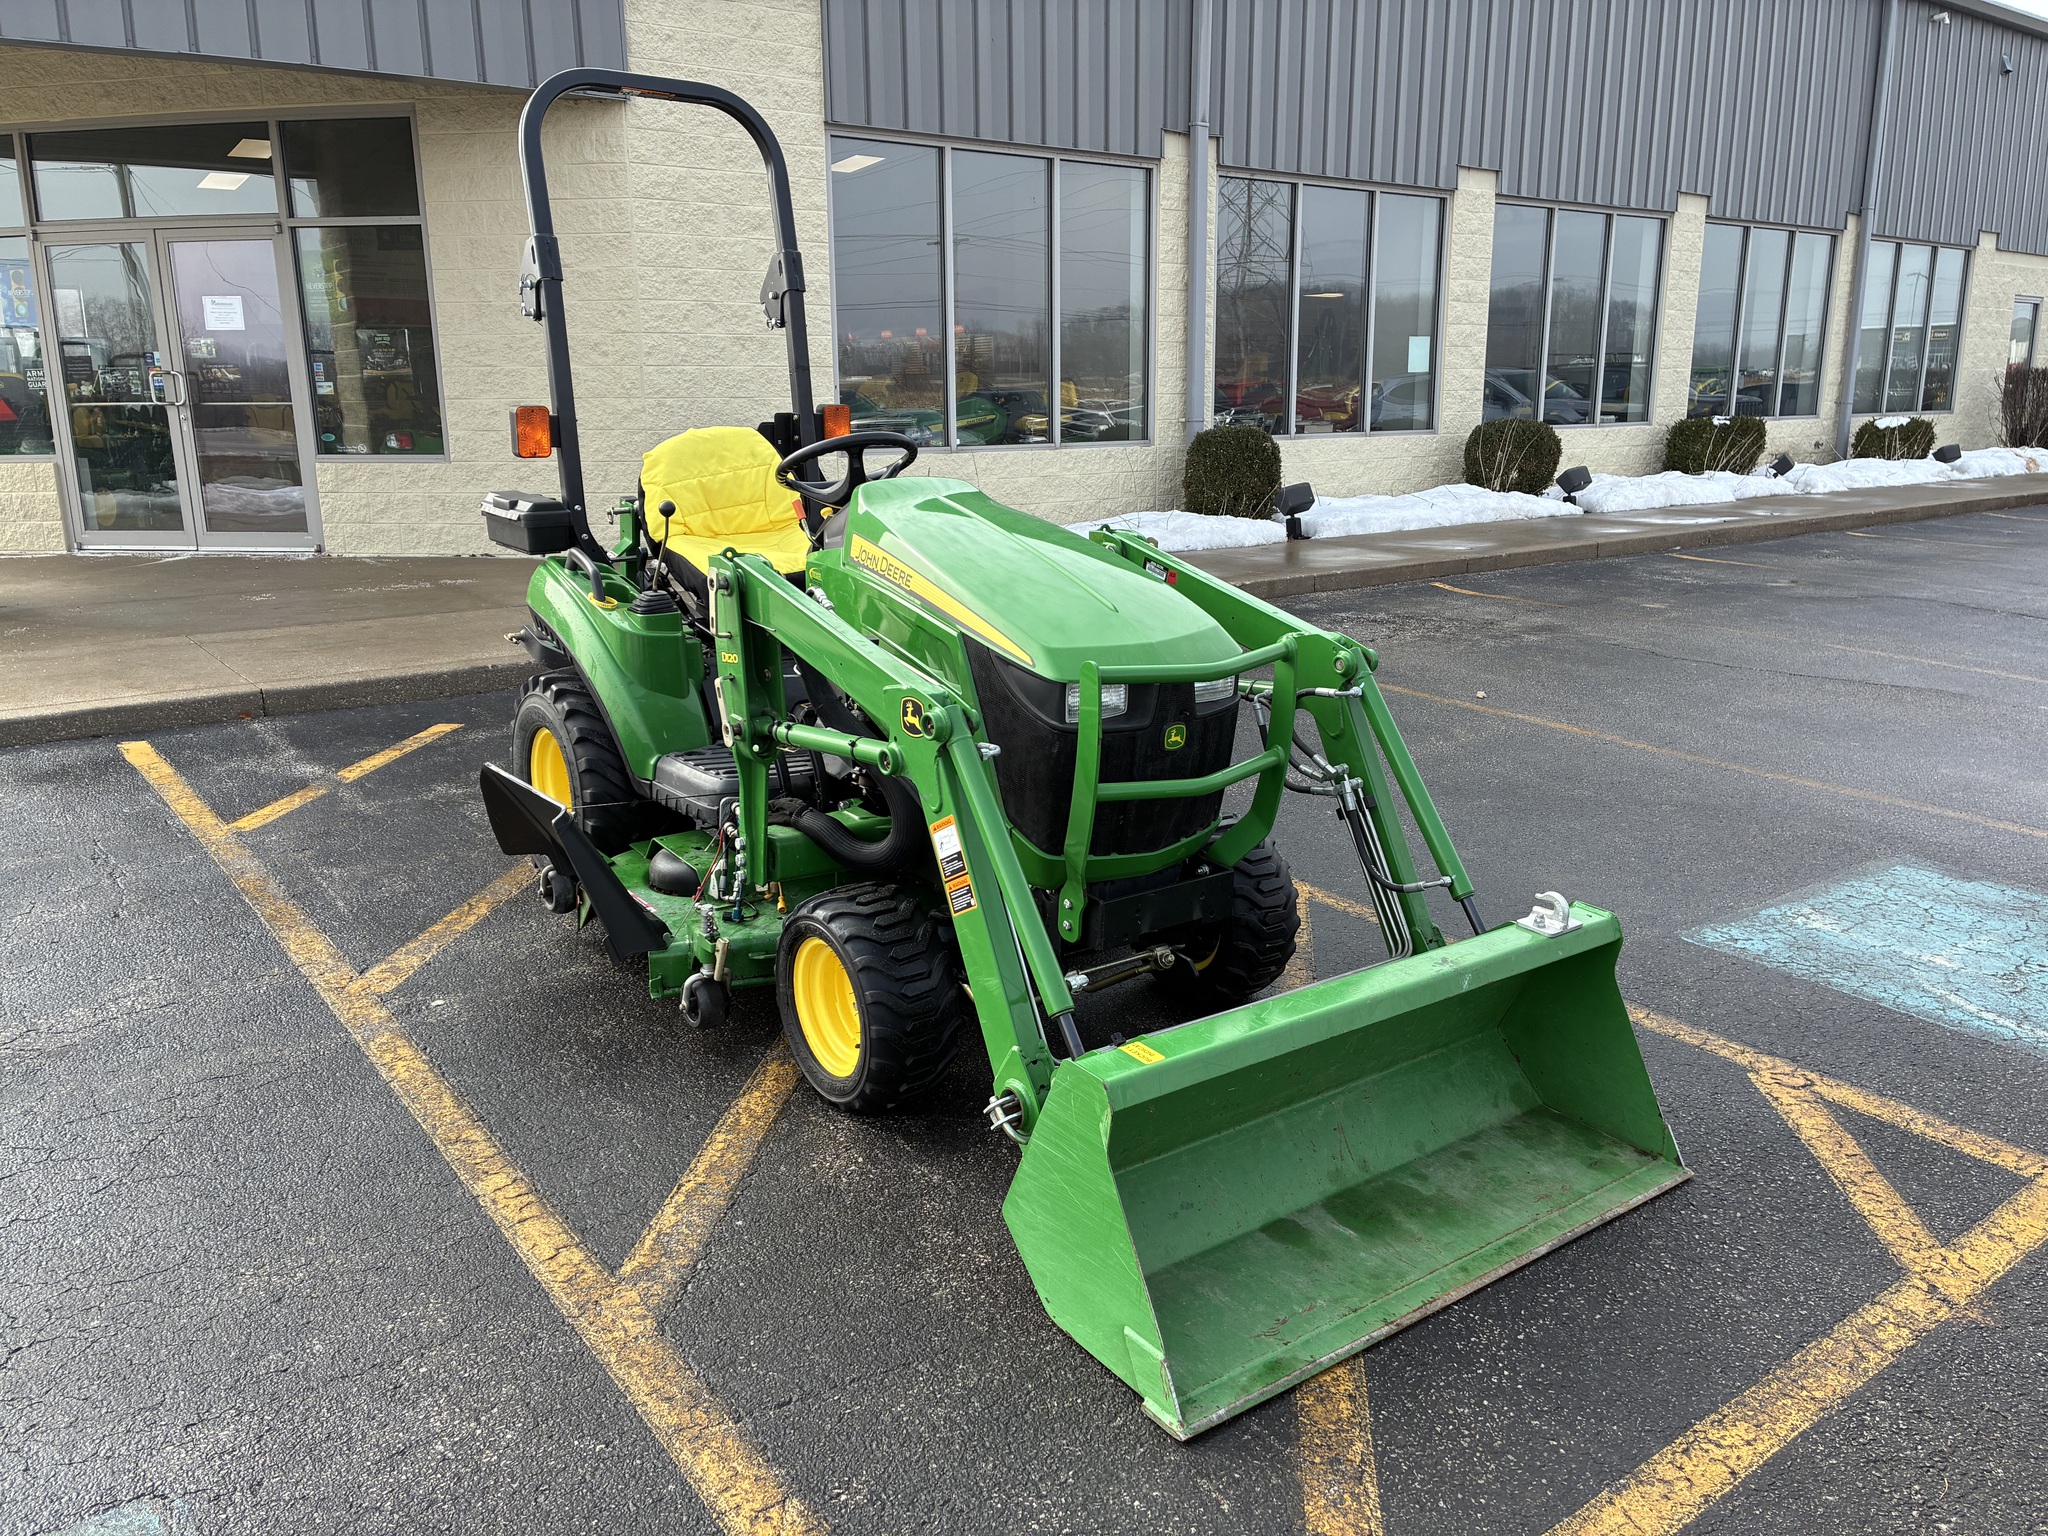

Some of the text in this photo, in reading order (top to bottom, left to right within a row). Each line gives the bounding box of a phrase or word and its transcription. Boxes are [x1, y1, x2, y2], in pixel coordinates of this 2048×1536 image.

[855, 545, 913, 588] JOHN DEERE
[721, 651, 738, 664] D120
